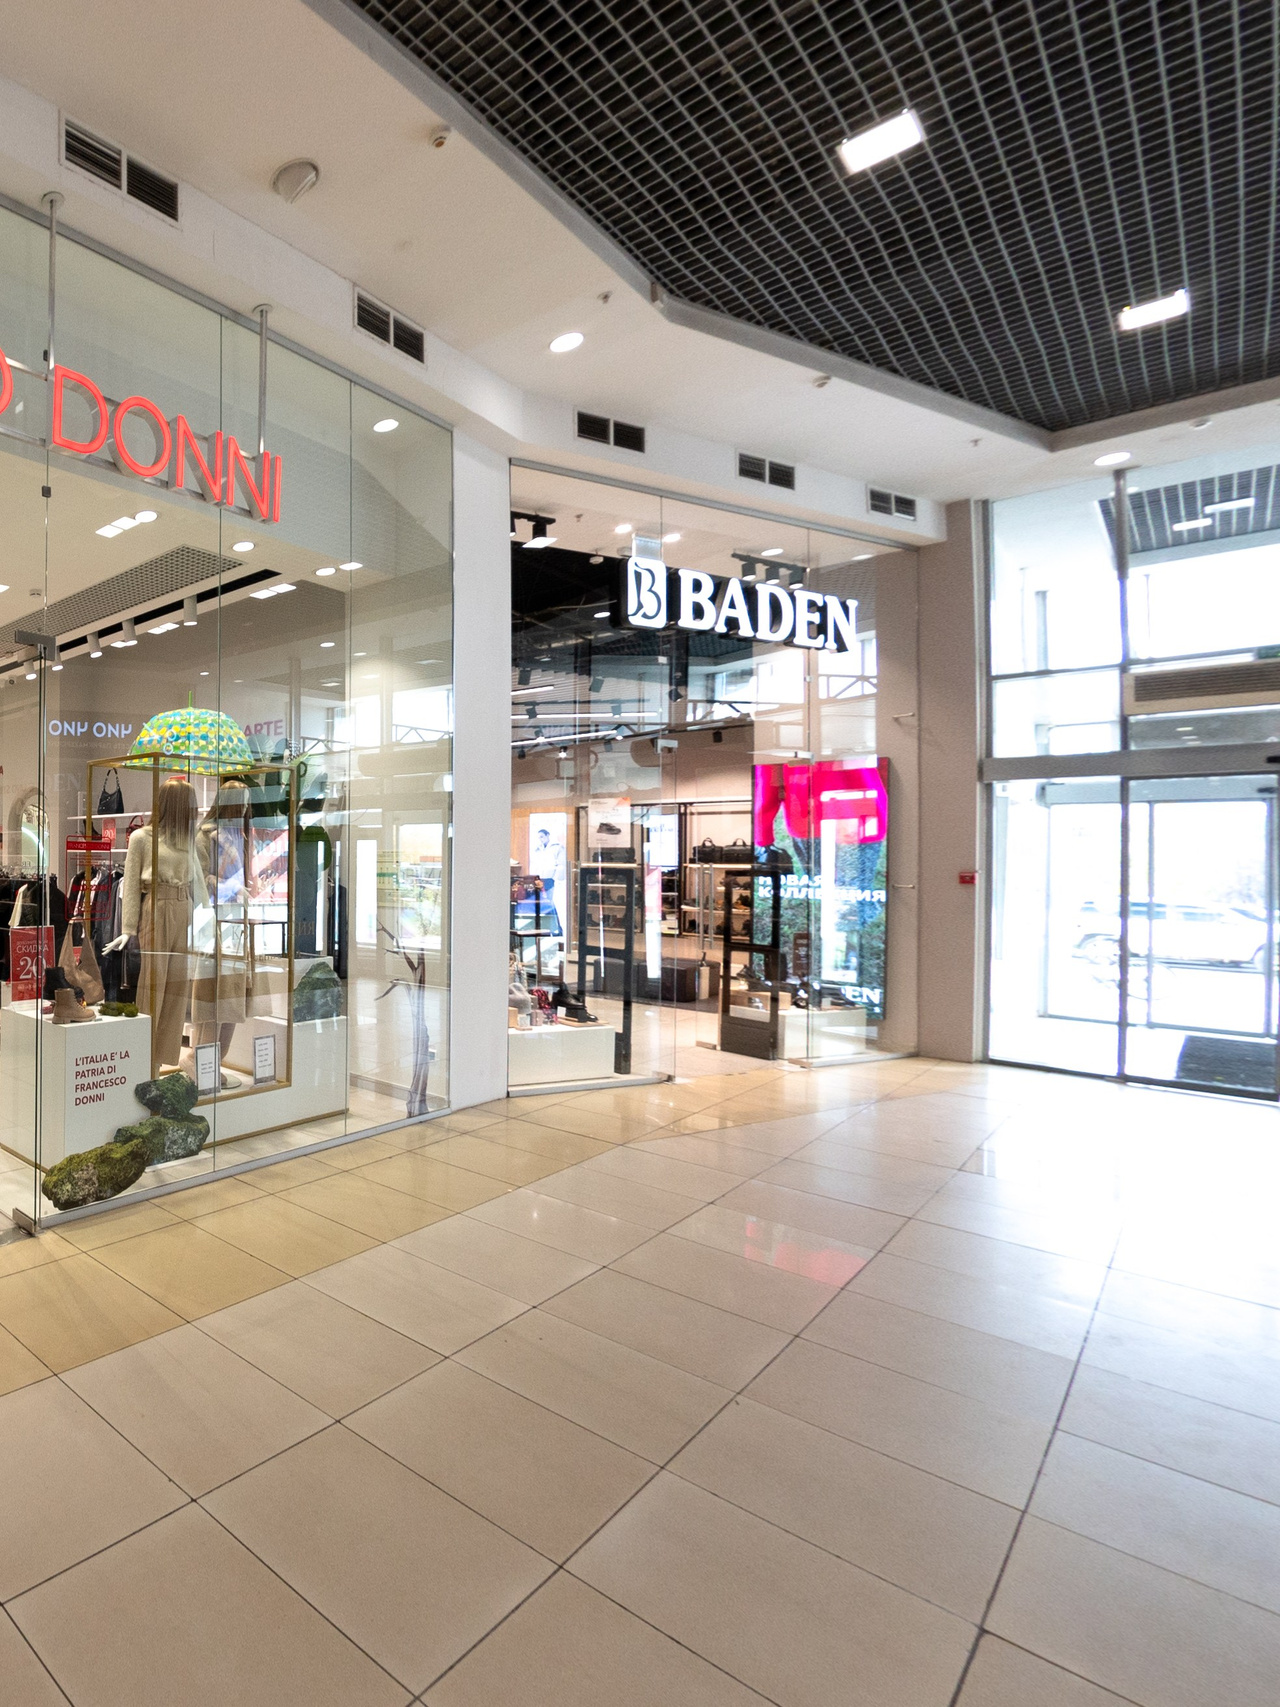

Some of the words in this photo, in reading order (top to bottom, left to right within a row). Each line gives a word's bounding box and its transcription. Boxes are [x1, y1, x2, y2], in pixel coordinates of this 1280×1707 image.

[53, 365, 282, 523] DONNI
[677, 567, 859, 651] BADEN
[16, 944, 49, 954] СКИДКА
[75, 1053, 108, 1067] L'ITALIA
[119, 1050, 130, 1060] LA
[75, 1067, 105, 1080] PATRIA
[107, 1065, 116, 1074] DI
[75, 1076, 127, 1093] FRANCESCO
[75, 1092, 105, 1107] DONNI
